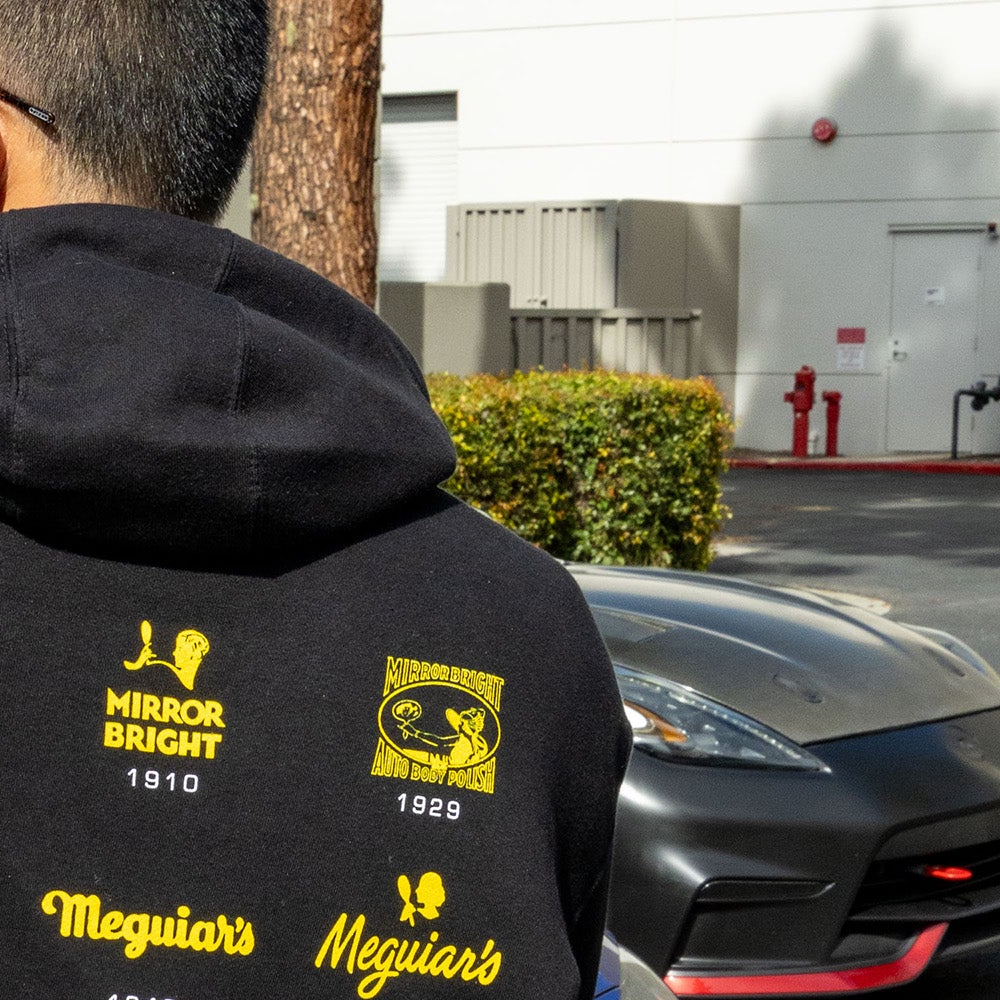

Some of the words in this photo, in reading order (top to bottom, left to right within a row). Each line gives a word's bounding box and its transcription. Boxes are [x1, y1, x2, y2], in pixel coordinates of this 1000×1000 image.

[105, 686, 227, 729] MIRROR
[383, 656, 449, 697] MIRROR
[449, 666, 505, 712] BRIGHT
[103, 721, 224, 760] BRIGHT
[127, 768, 199, 793] 1910
[371, 737, 410, 779] AUTO
[448, 757, 497, 794] POLISH
[397, 792, 461, 820] 1929
[38, 889, 258, 960] Meguiar's
[312, 911, 504, 1000] Meguiar's
